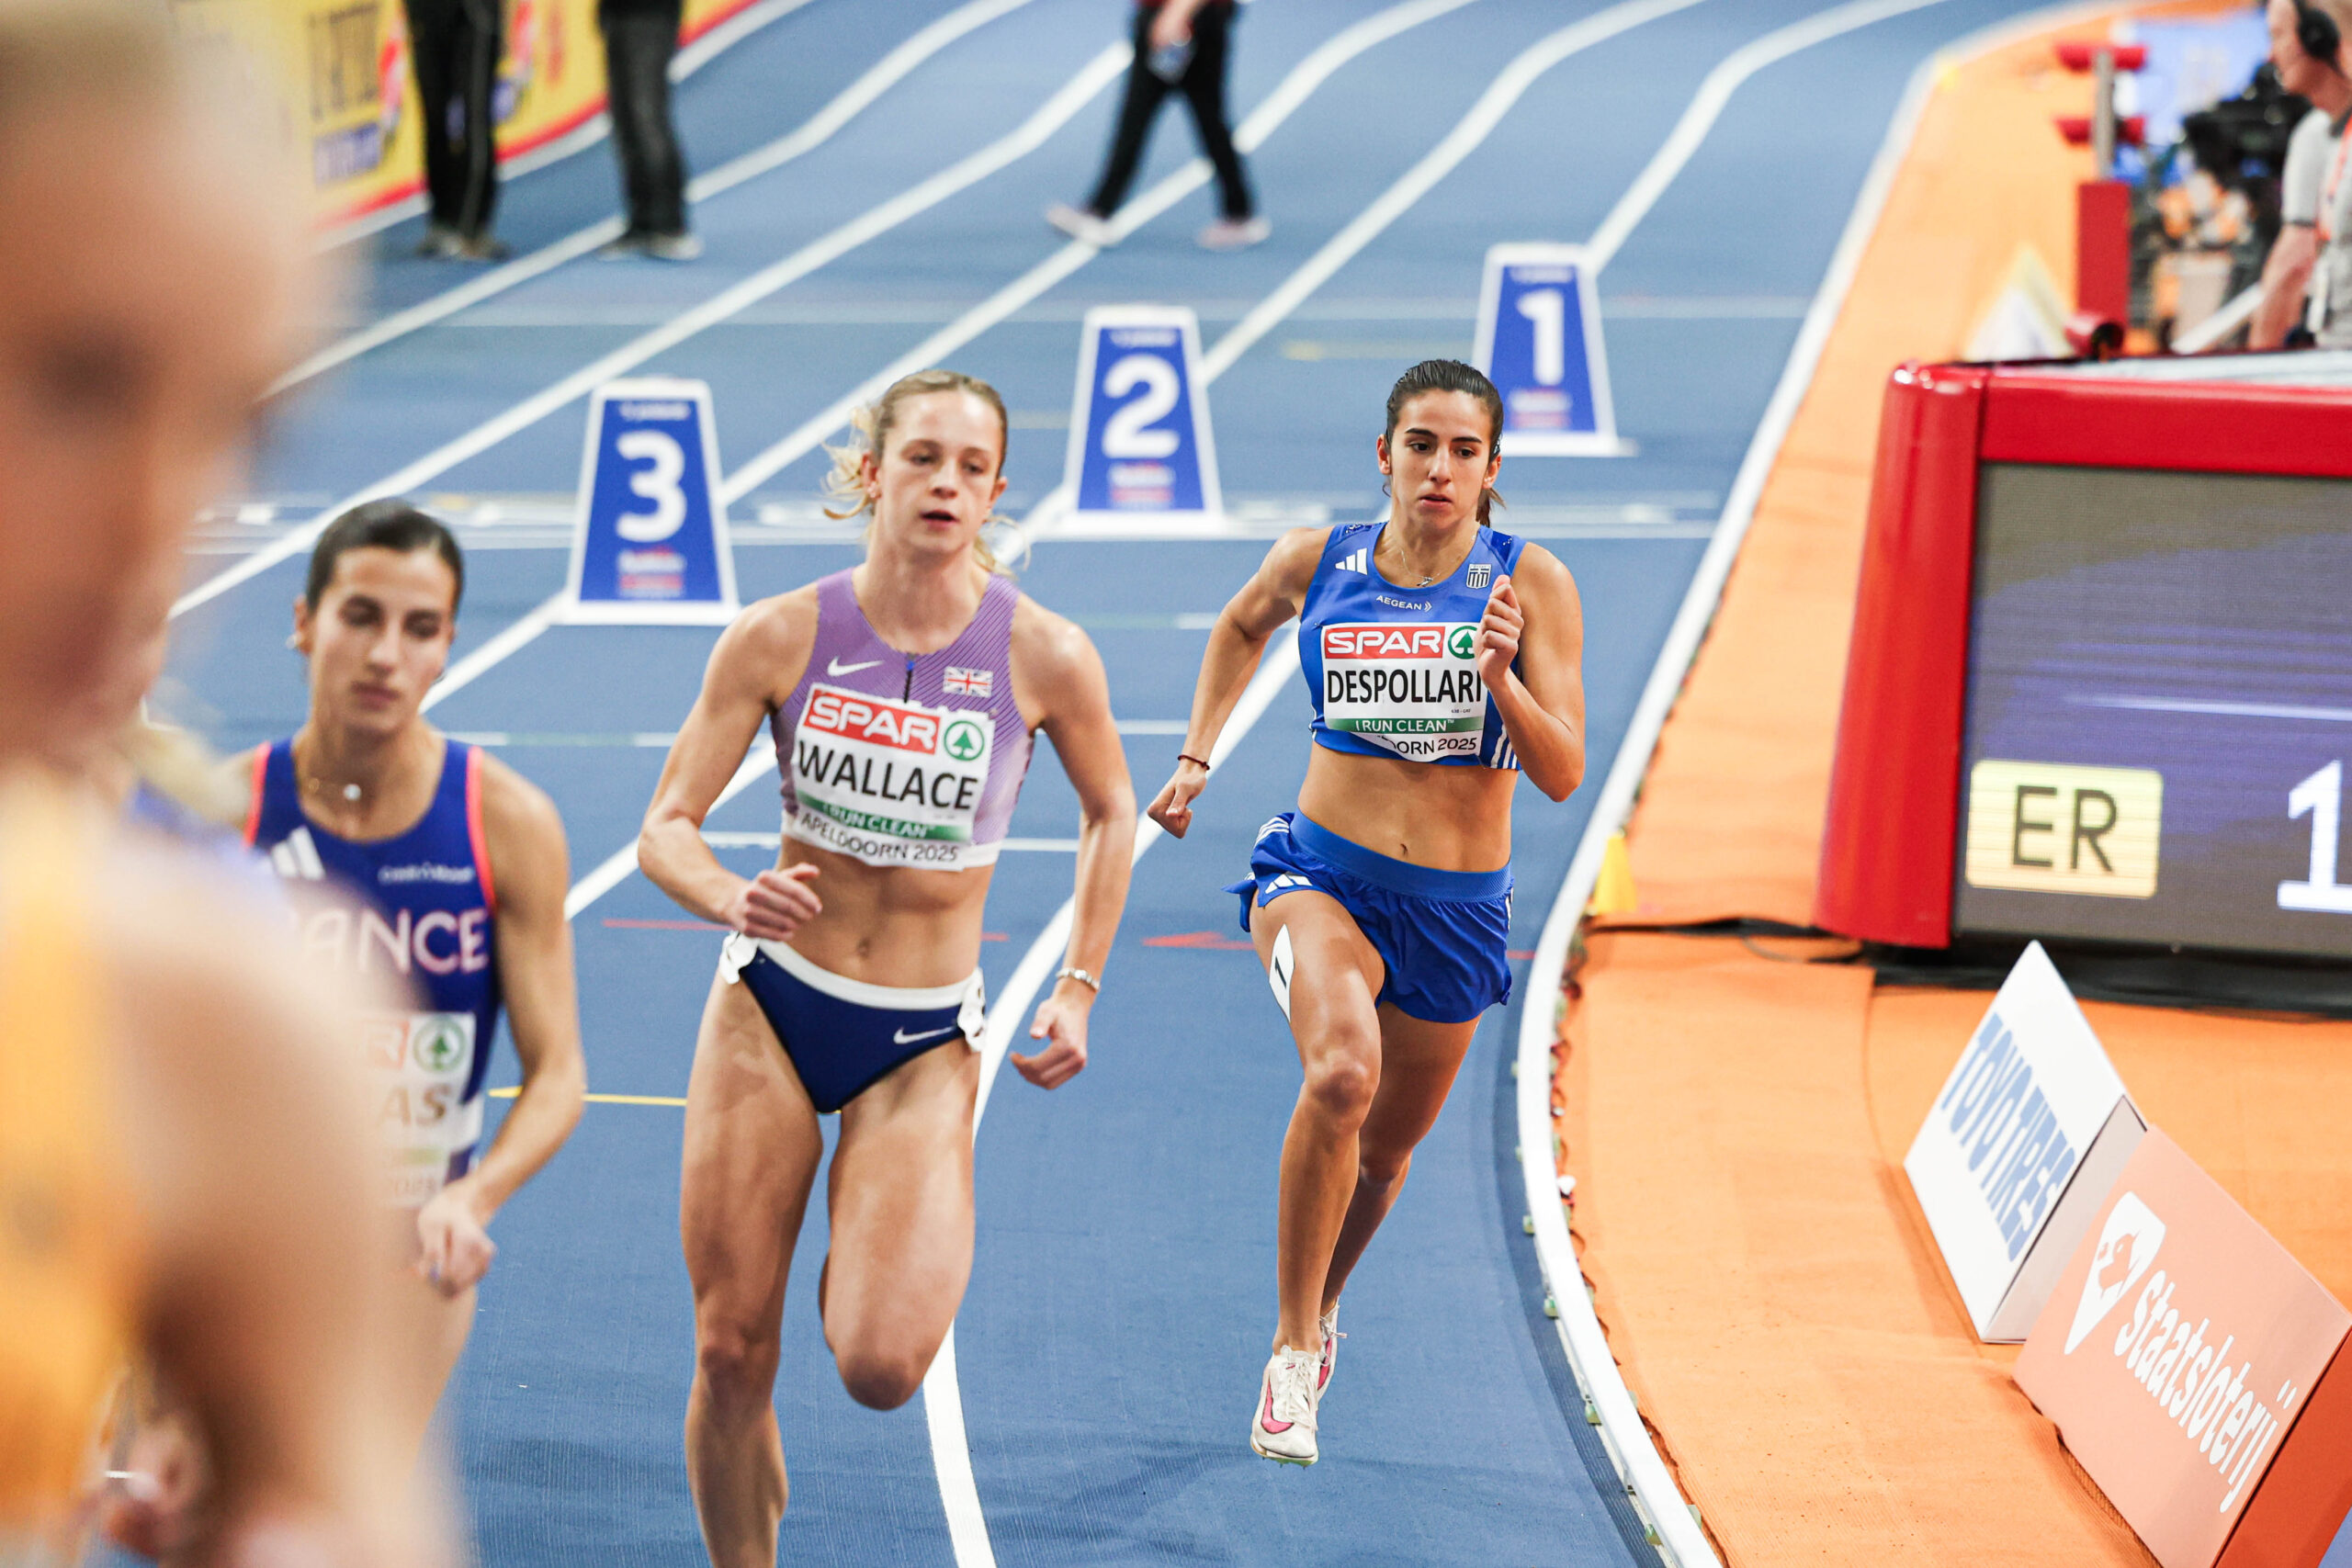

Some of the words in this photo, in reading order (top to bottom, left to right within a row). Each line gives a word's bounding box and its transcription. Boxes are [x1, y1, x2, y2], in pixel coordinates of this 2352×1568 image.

[1517, 289, 1565, 386] 1
[1103, 353, 1181, 458] 2
[616, 430, 687, 542] 3
[1375, 595, 1422, 610] AEGEAN
[1327, 630, 1442, 655] SPAR
[1327, 669, 1482, 704] DESPOLLARI
[808, 694, 938, 750] SPAR
[1363, 720, 1393, 732] RUN
[1438, 738, 1477, 750] 2025
[797, 740, 978, 811] WALLACE
[800, 812, 909, 859] APELDOORN
[913, 843, 960, 863] 2025
[2011, 784, 2118, 873] ER
[2277, 760, 2352, 914] 1
[303, 906, 489, 975] ANCE
[2113, 1269, 2298, 1514] Staatsloterij
